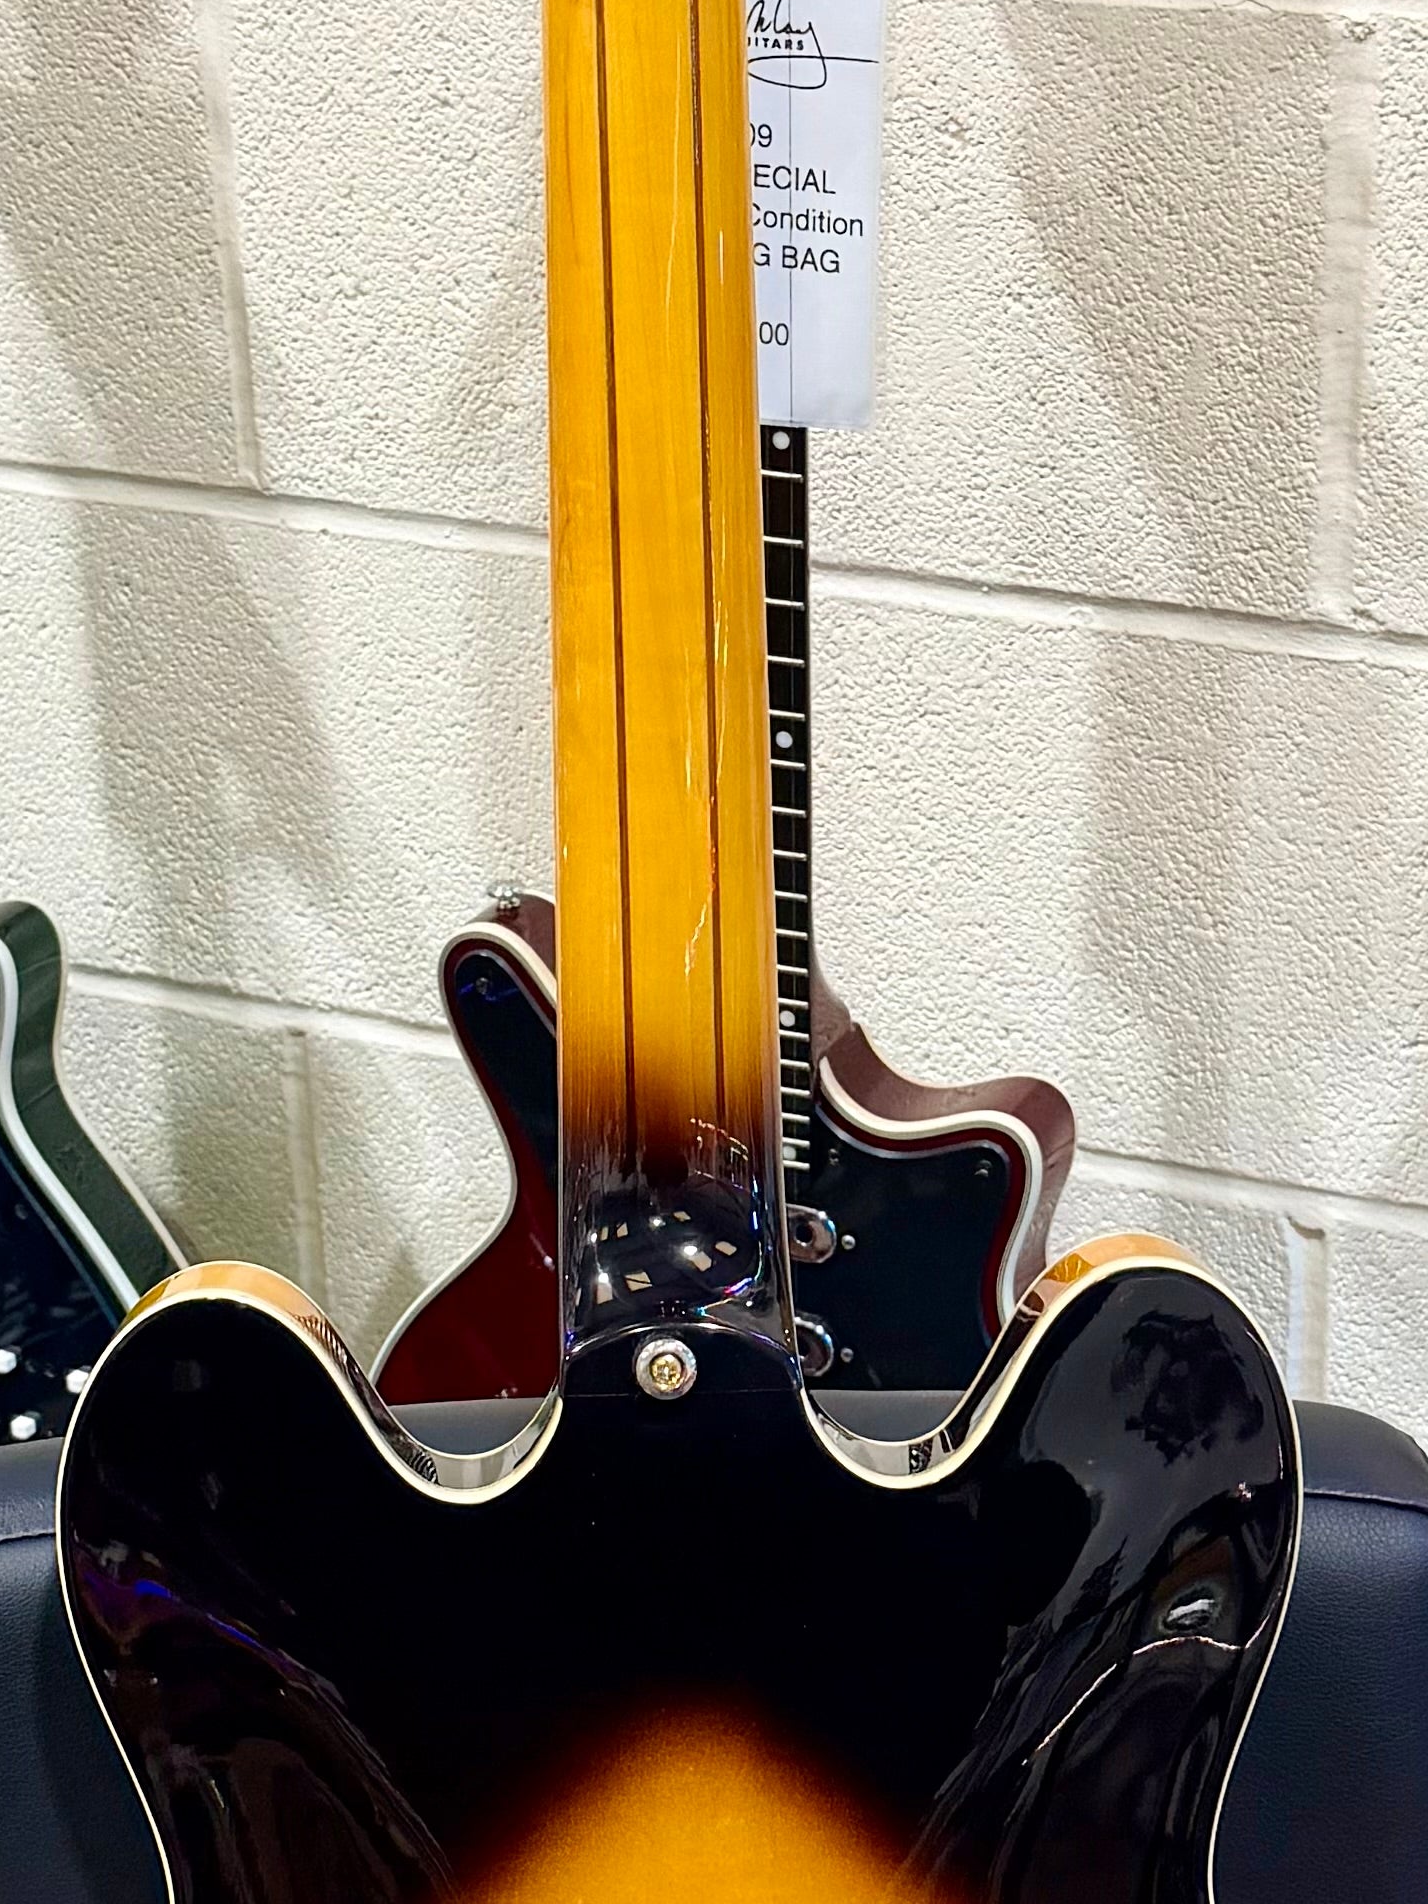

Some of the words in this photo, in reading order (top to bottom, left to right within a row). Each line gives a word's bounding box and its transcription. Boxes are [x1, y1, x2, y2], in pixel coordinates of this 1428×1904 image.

[747, 36, 804, 51] ITARS
[753, 164, 837, 195] ECIAL
[781, 244, 841, 274] BAG
